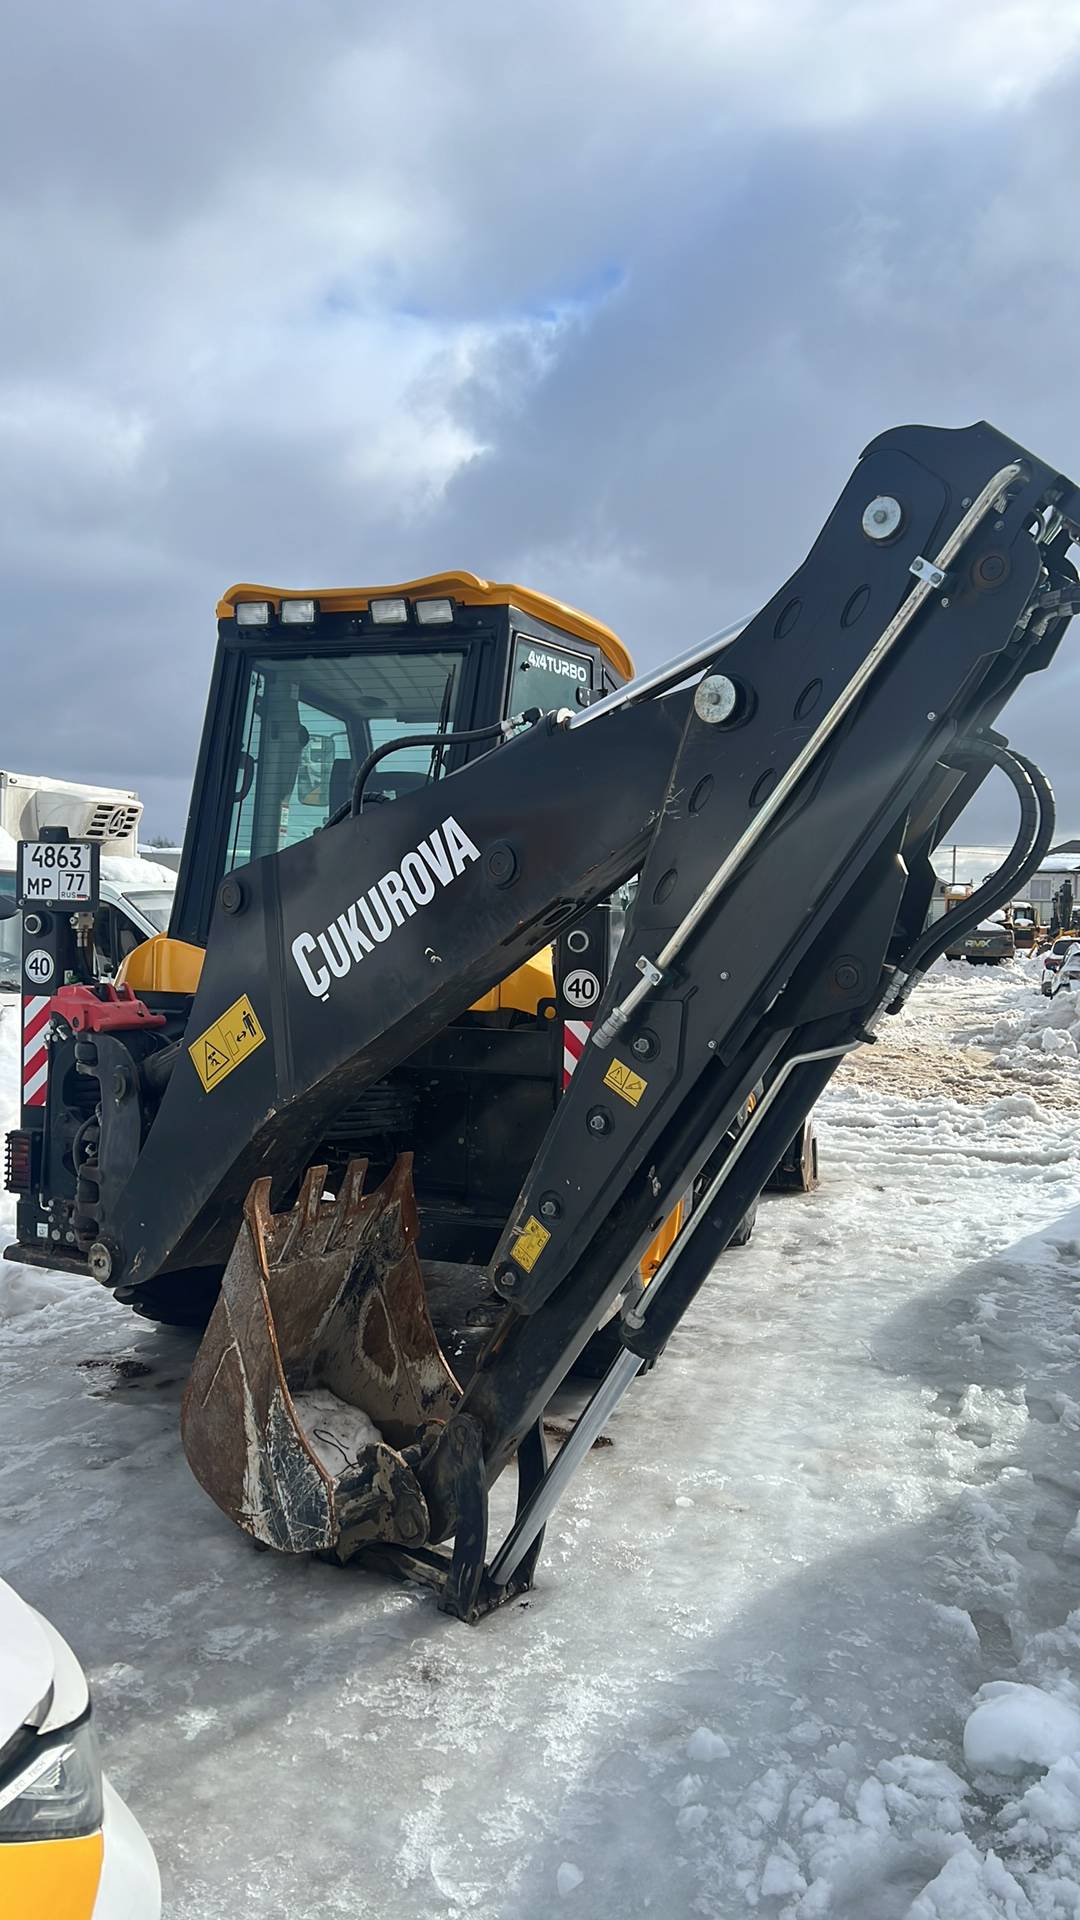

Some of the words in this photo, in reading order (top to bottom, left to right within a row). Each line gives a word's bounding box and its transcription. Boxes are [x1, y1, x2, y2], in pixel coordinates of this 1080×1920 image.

[32, 846, 82, 868] 4863
[27, 878, 52, 896] MP
[65, 874, 85, 891] 77
[61, 891, 76, 899] RUS
[291, 816, 482, 1002] ÇUKUROVA
[29, 957, 50, 976] 40
[567, 978, 595, 999] 40
